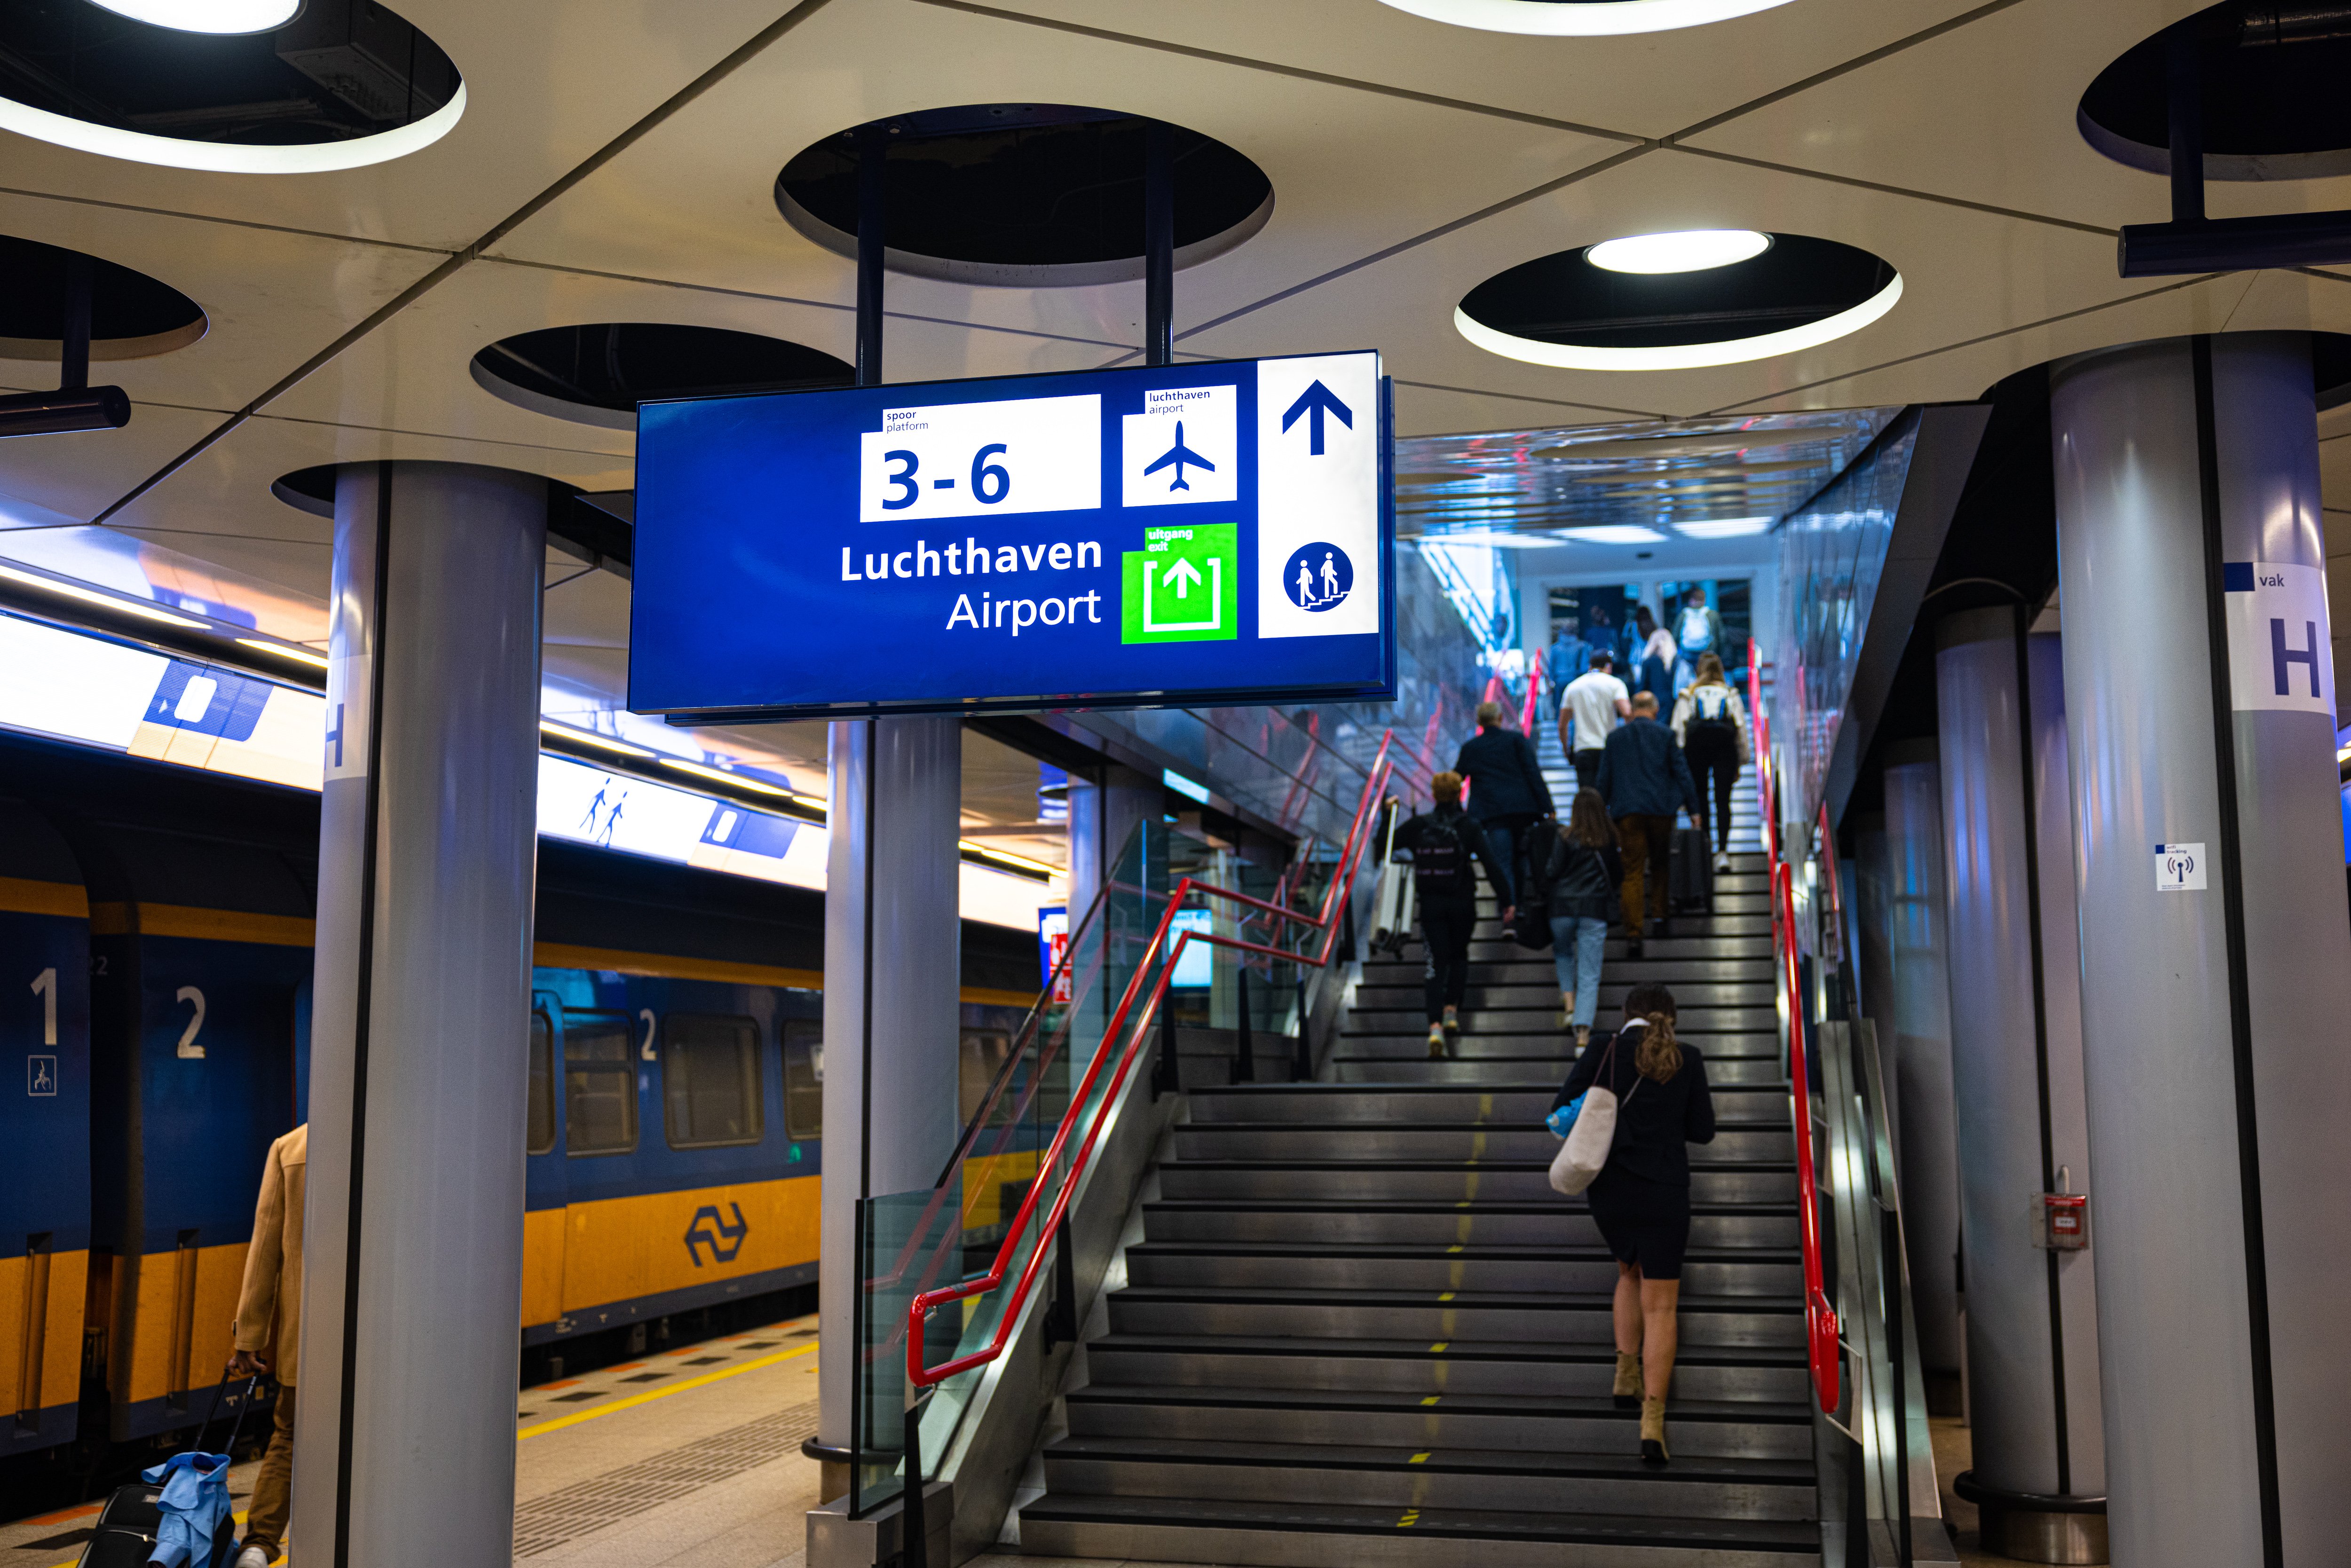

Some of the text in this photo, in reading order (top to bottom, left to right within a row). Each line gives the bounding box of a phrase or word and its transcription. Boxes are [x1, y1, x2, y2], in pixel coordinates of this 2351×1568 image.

[1150, 391, 1210, 402] luchthaven
[1150, 404, 1184, 415] airport
[887, 412, 916, 422] spoor
[887, 421, 928, 433] platform
[1149, 528, 1193, 541] uitgang
[1148, 541, 1168, 552] exit
[842, 537, 1101, 581] Luchthaven
[2259, 573, 2285, 587] vak
[946, 589, 1101, 637] Airport
[2270, 618, 2320, 698] H
[30, 967, 57, 1046] 1
[176, 985, 206, 1059] 2
[639, 1008, 657, 1062] 2
